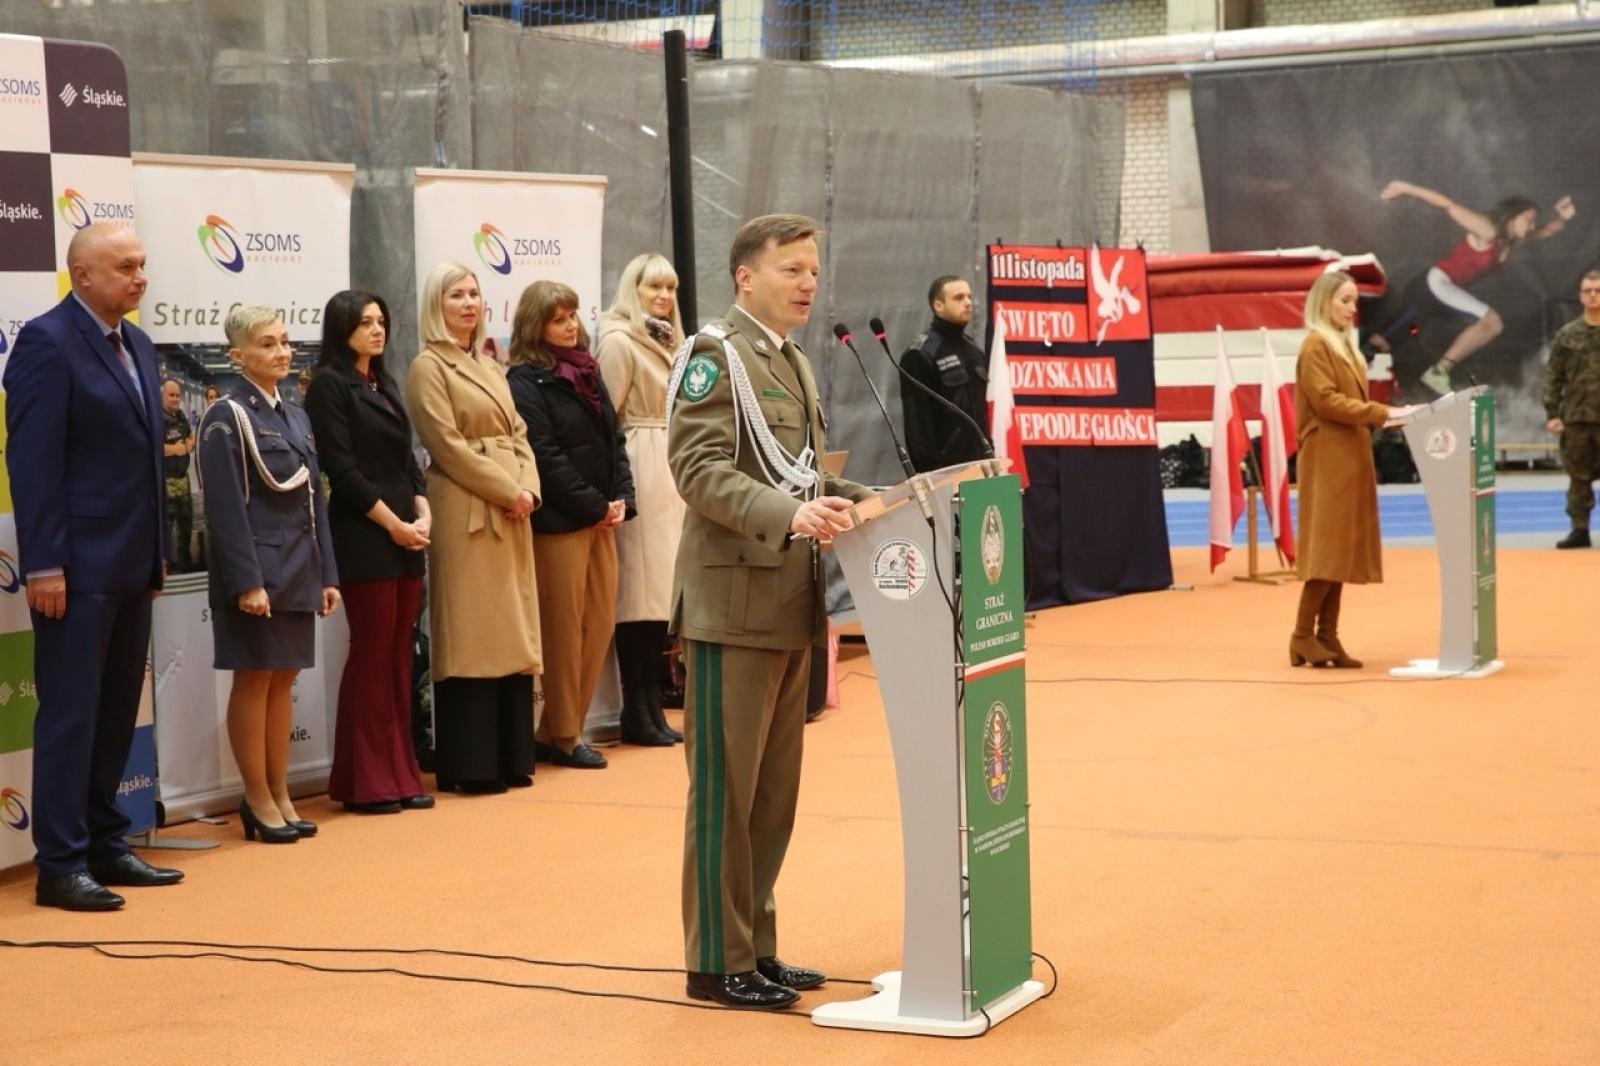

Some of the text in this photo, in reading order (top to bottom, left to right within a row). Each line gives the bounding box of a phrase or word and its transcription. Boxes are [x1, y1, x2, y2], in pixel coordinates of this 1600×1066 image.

[83, 84, 127, 109] Śląskie.
[94, 203, 135, 219] ZSOMS
[245, 233, 302, 252] ZSOMS
[514, 239, 561, 256] ZSOMS
[153, 301, 220, 326] Straż
